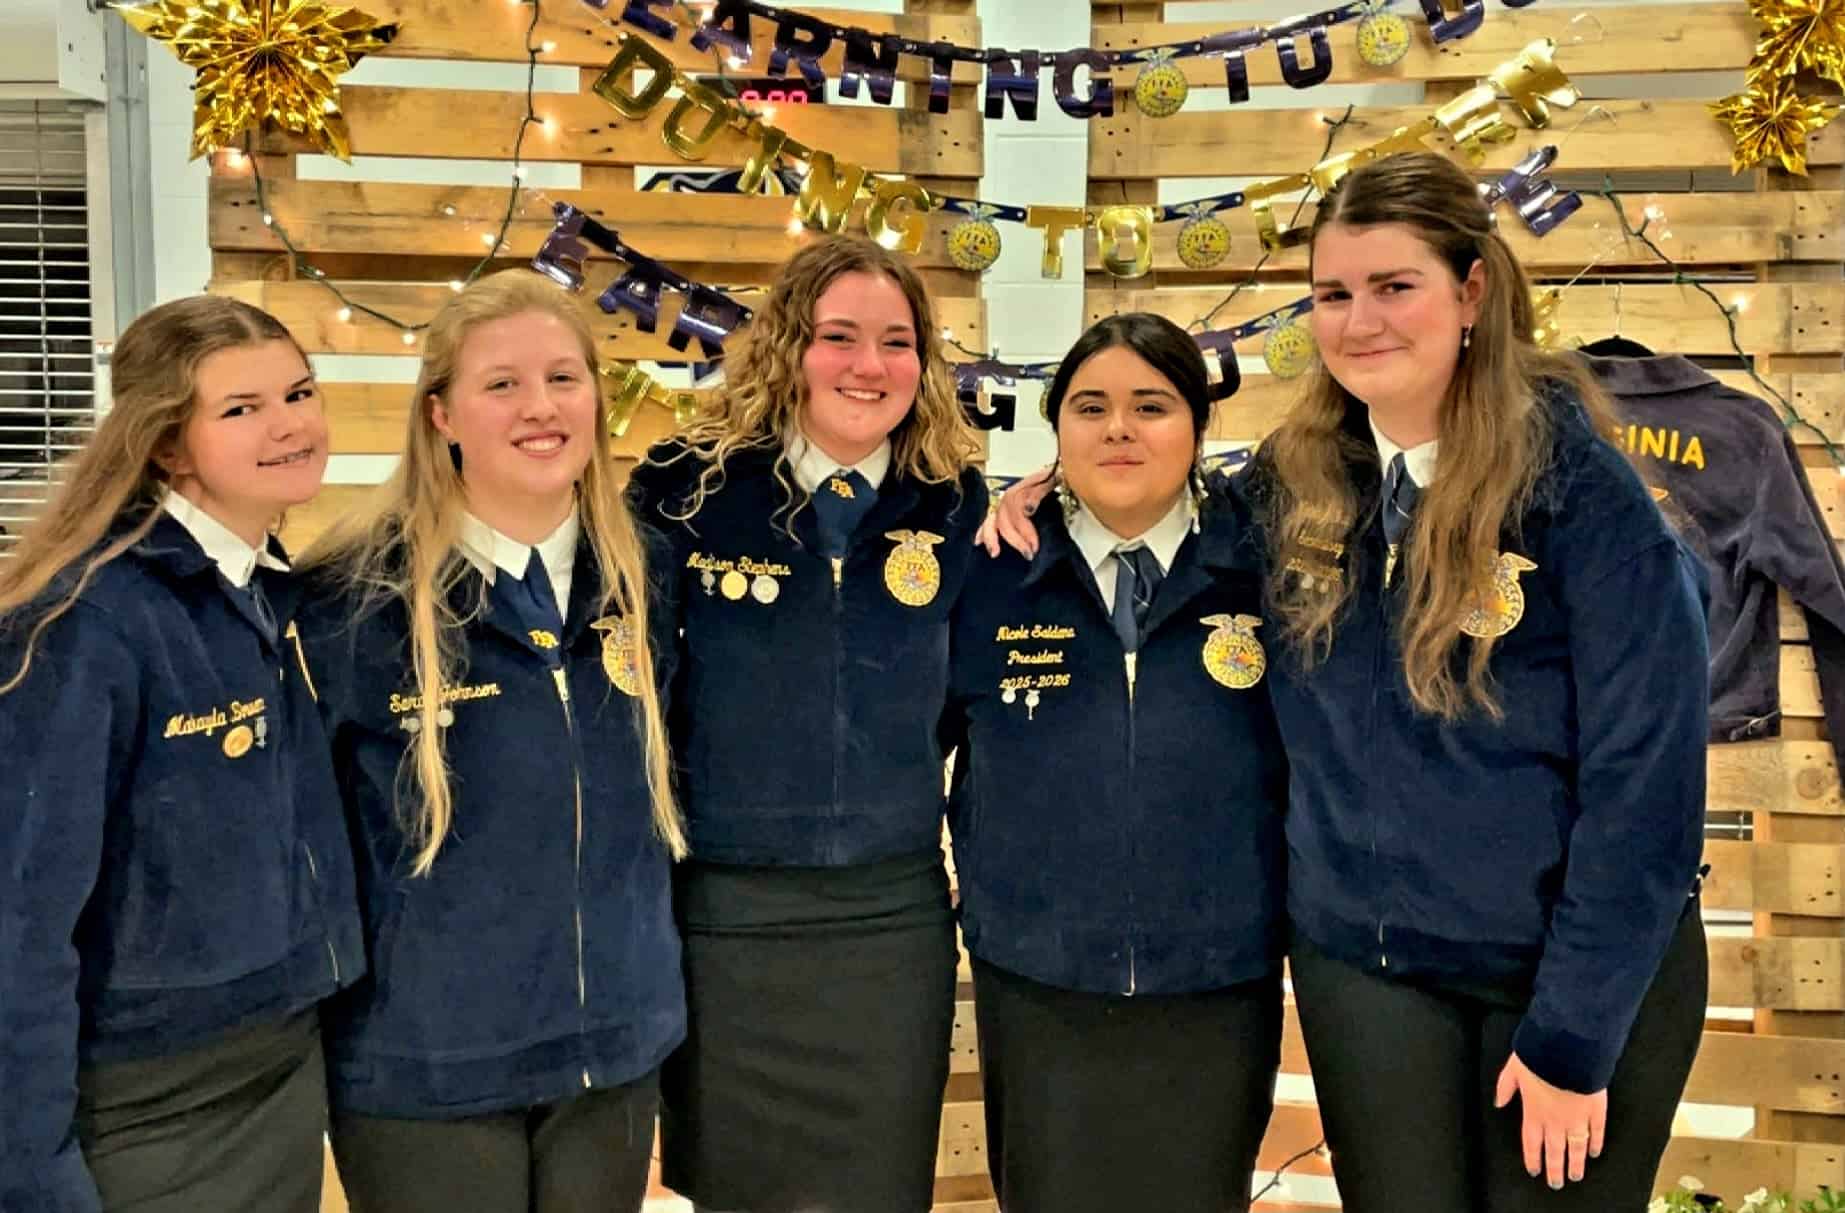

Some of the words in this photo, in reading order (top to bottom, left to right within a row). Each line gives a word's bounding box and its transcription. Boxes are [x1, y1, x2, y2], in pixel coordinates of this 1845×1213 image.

[1200, 24, 1333, 103] TO
[592, 31, 931, 255] DOING
[1027, 205, 1153, 280] TO
[998, 673, 1072, 689] 2025-2026
[1007, 648, 1064, 666] President
